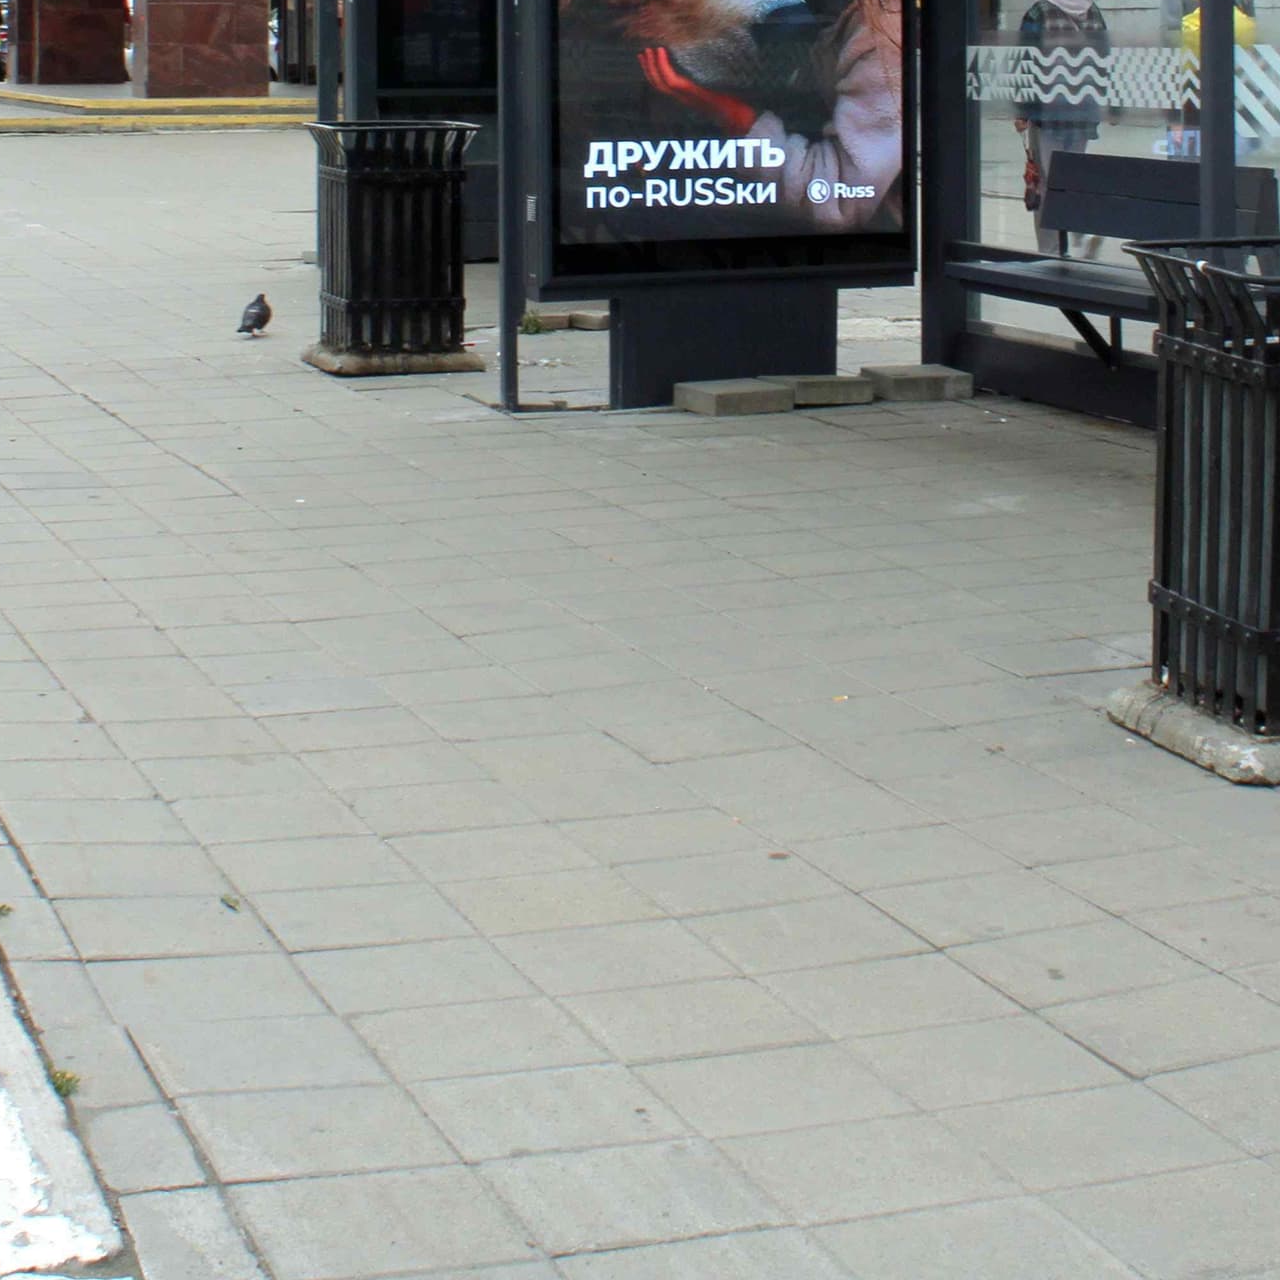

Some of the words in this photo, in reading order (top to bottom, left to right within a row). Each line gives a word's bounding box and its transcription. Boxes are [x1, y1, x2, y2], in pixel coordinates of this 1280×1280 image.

[583, 138, 786, 178] ДРУЖИТЬ
[586, 177, 777, 209] по-RUSSки
[833, 183, 875, 199] Russ
